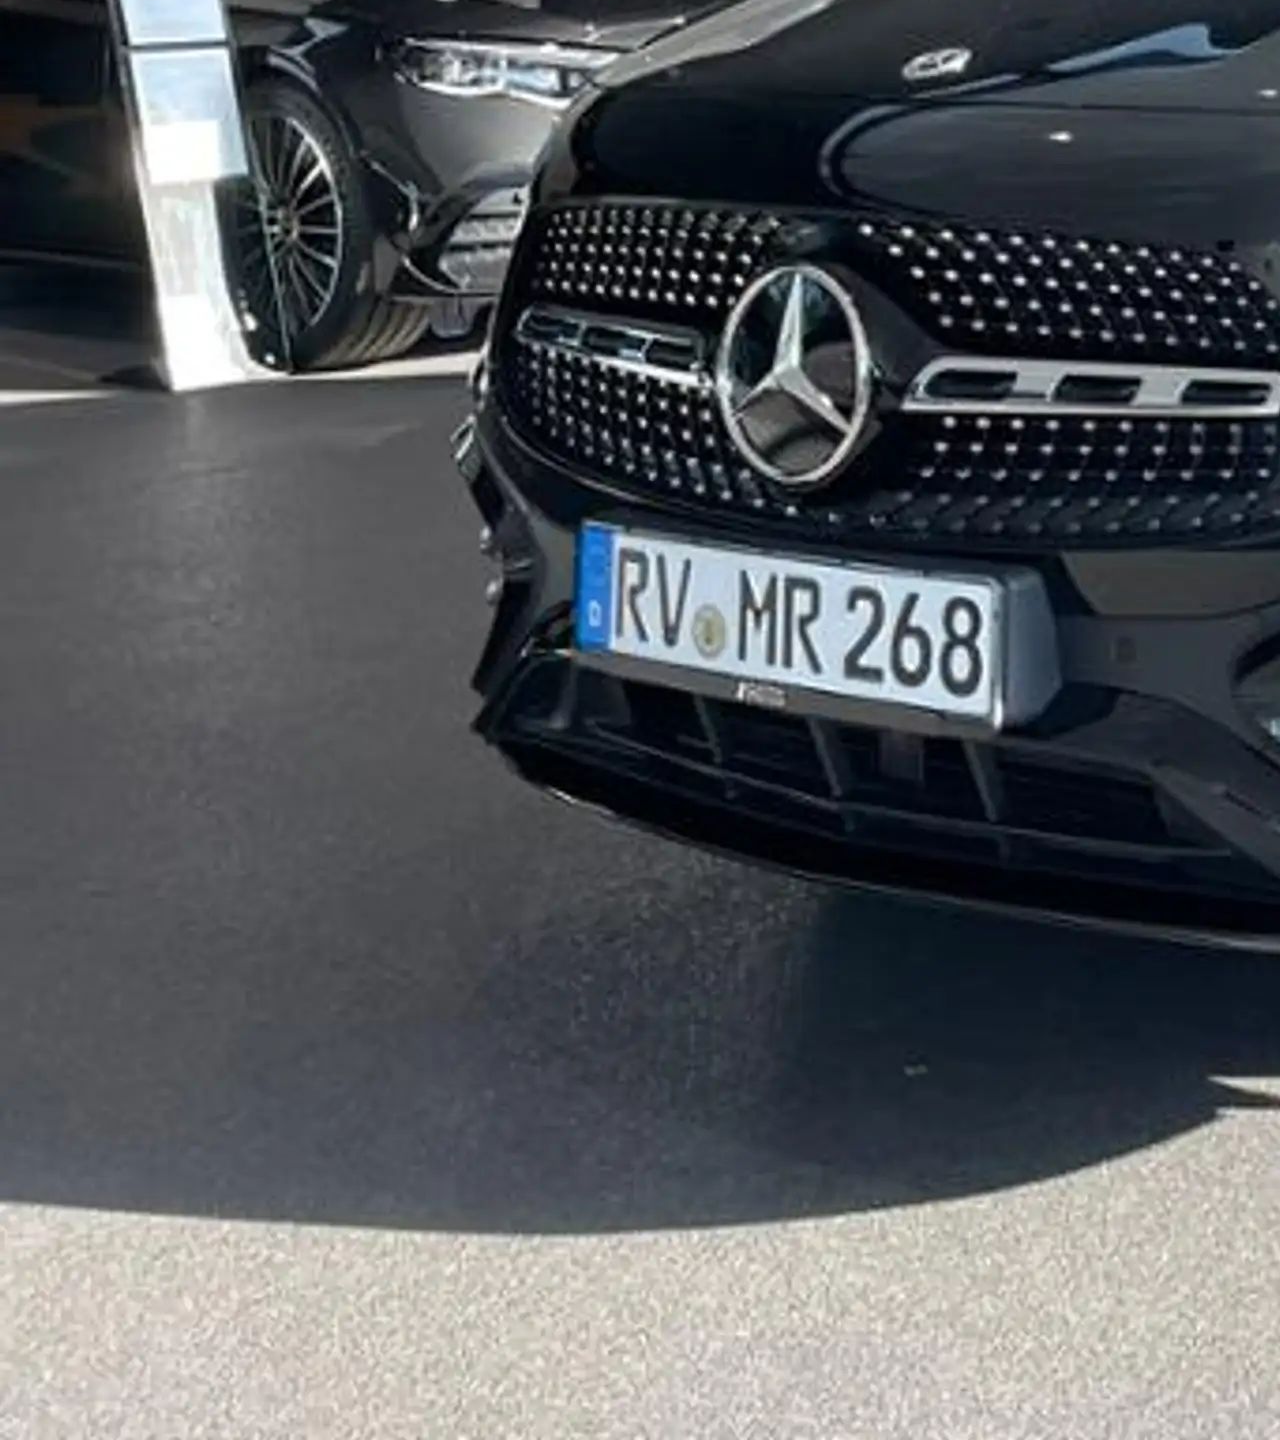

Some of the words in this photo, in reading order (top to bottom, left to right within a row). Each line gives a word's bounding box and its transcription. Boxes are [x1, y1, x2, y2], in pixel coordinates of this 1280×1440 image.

[616, 547, 692, 646] RV
[738, 569, 822, 675] MR
[843, 587, 983, 696] 268
